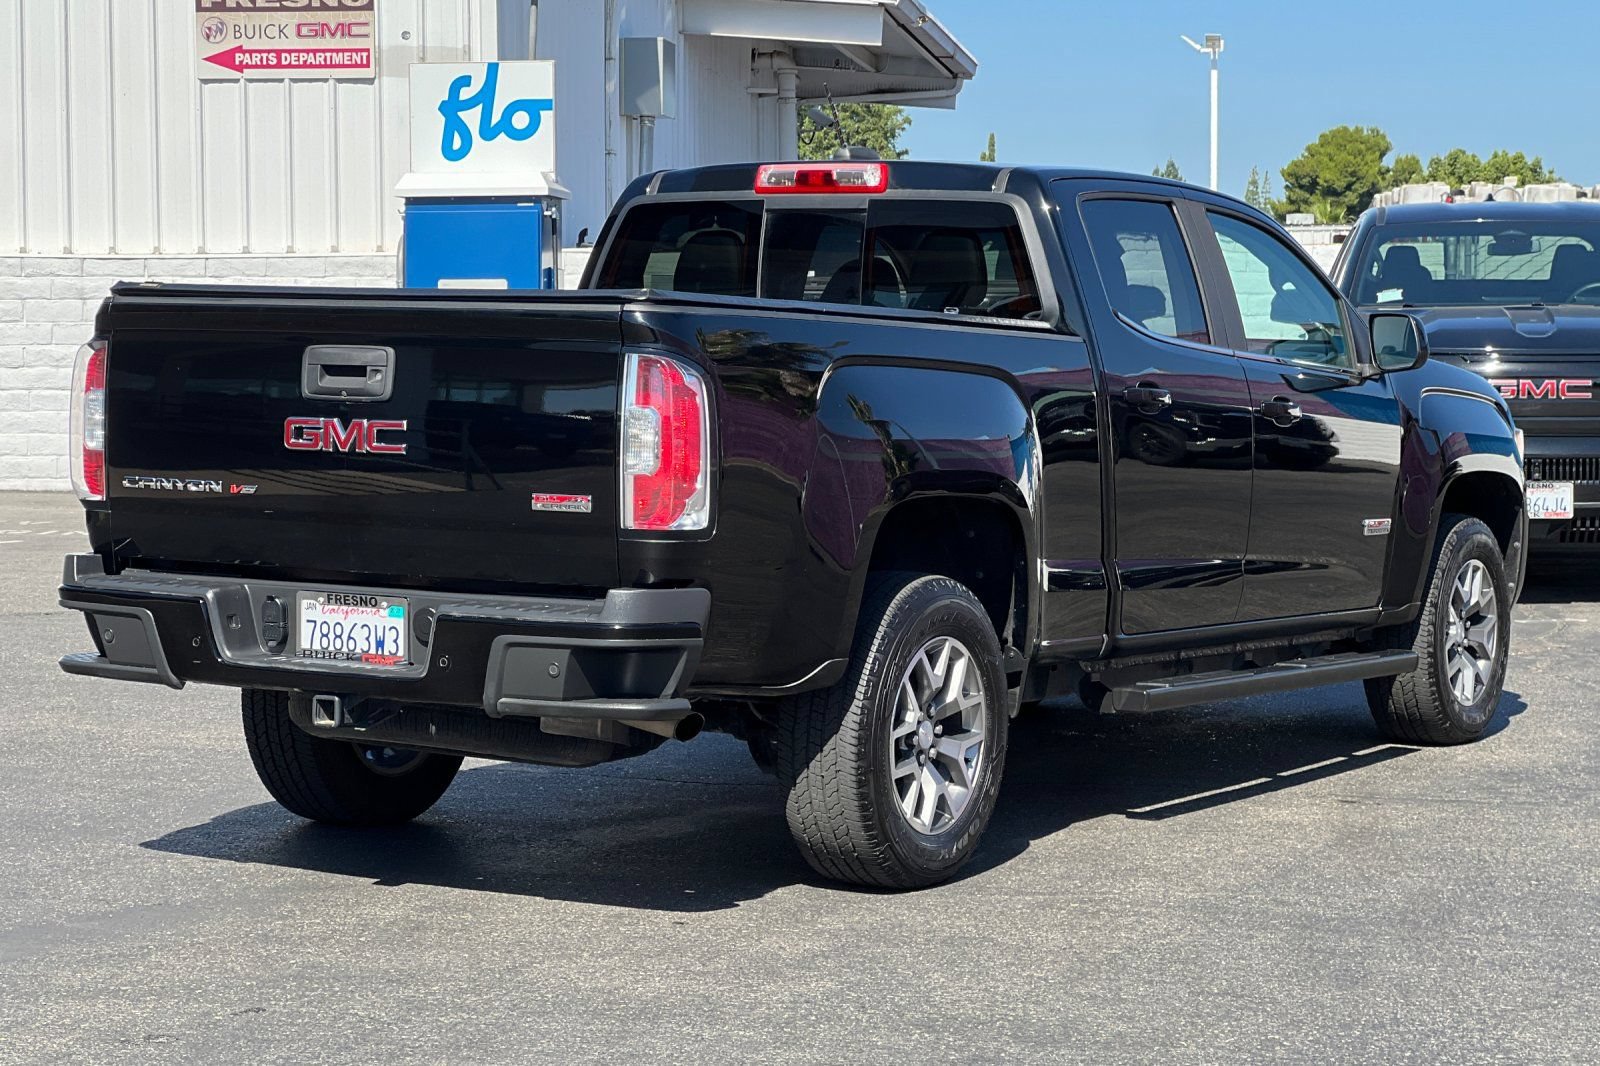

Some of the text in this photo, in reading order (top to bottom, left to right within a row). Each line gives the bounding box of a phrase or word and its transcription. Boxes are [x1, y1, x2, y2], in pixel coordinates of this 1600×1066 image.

[233, 22, 370, 39] BUICK GMC
[235, 52, 368, 65] PARTS DEPARTMENT
[438, 62, 553, 162] flo
[1488, 379, 1592, 399] GMC
[284, 416, 407, 454] GMC
[122, 475, 258, 494] CANYON V6
[327, 593, 378, 608] FRESNO
[305, 601, 317, 611] JAN
[321, 603, 387, 621] California
[306, 619, 399, 656] 78863W3
